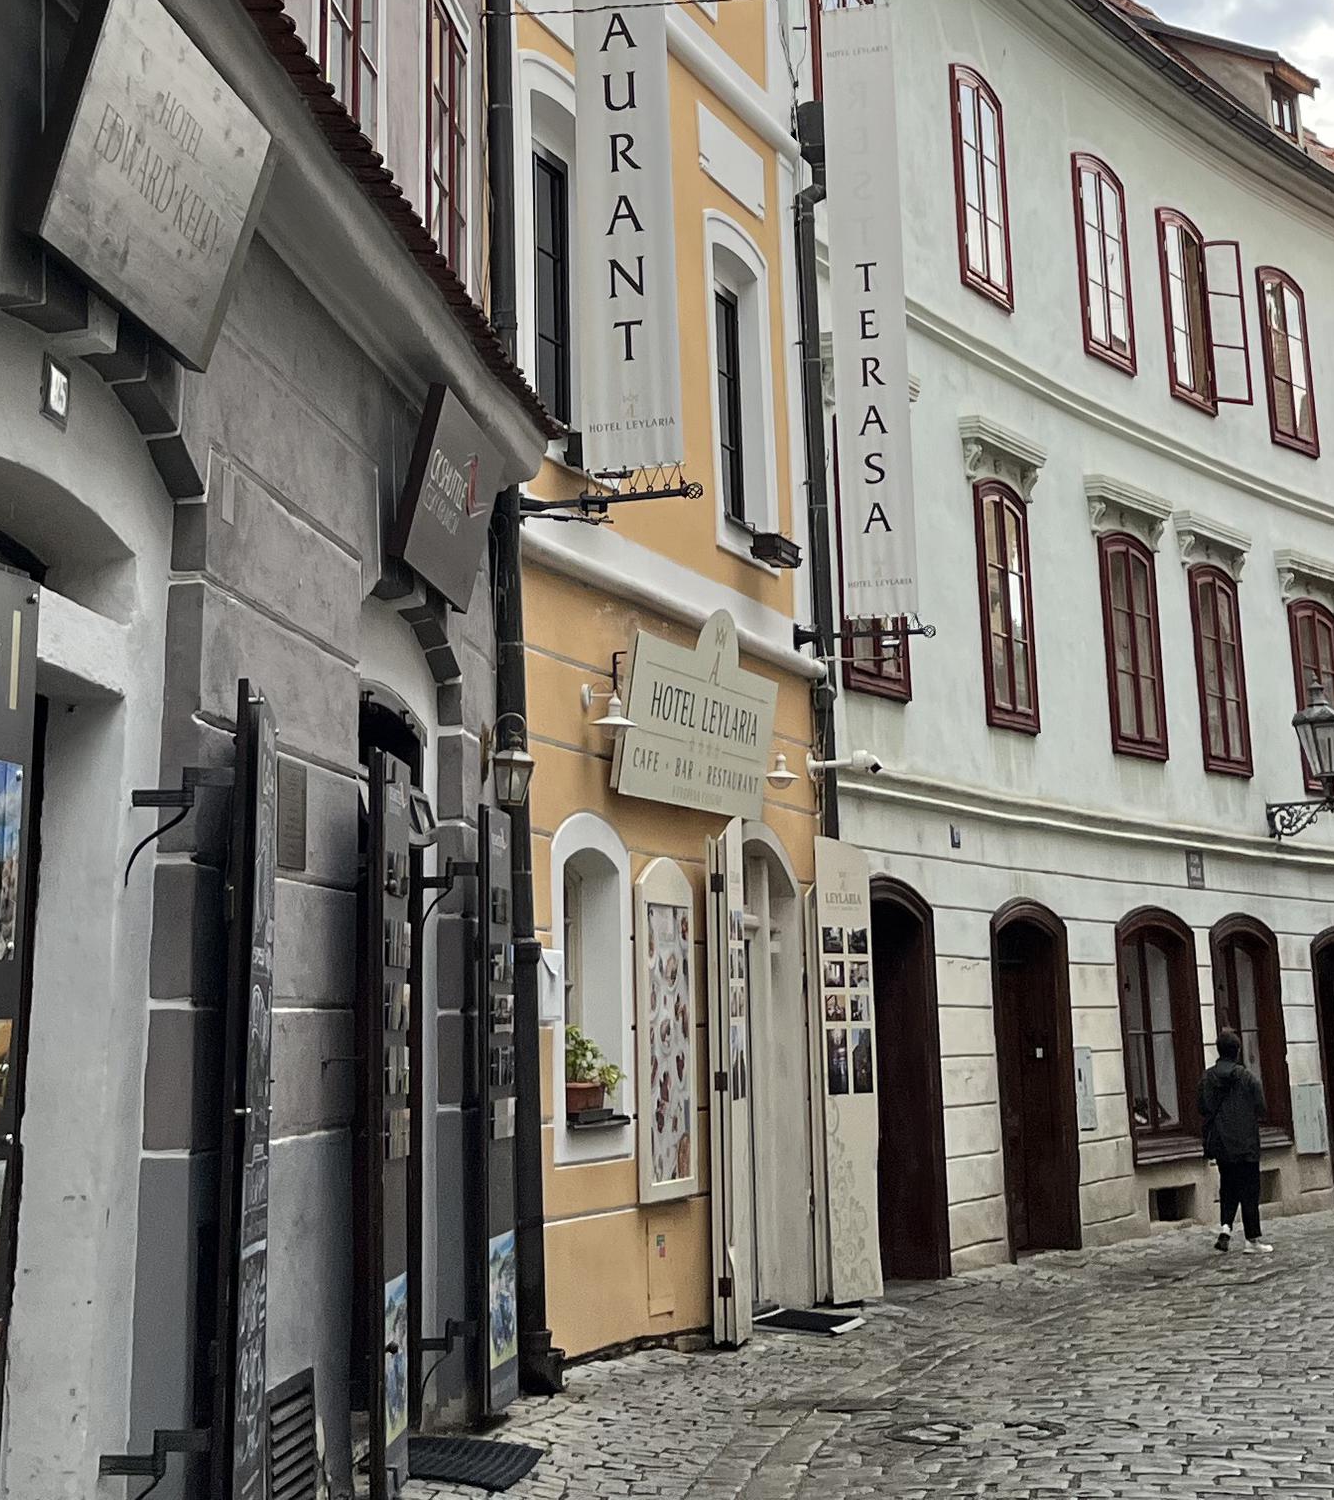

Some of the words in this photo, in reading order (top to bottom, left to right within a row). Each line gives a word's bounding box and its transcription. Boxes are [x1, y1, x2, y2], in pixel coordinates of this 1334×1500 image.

[158, 91, 204, 161] HOTEL
[93, 102, 176, 214] EDWARD
[173, 183, 225, 260] KELLY
[589, 422, 622, 433] HOTEL
[626, 416, 675, 430] LEYLARIA
[855, 262, 892, 534] TERASA
[847, 580, 872, 588] HOTEL
[650, 681, 696, 729] HOTEL
[701, 697, 758, 746] LEYLARIA
[633, 747, 660, 773] CAFE
[674, 757, 694, 781] BAR
[706, 765, 759, 795] RESTAURANT
